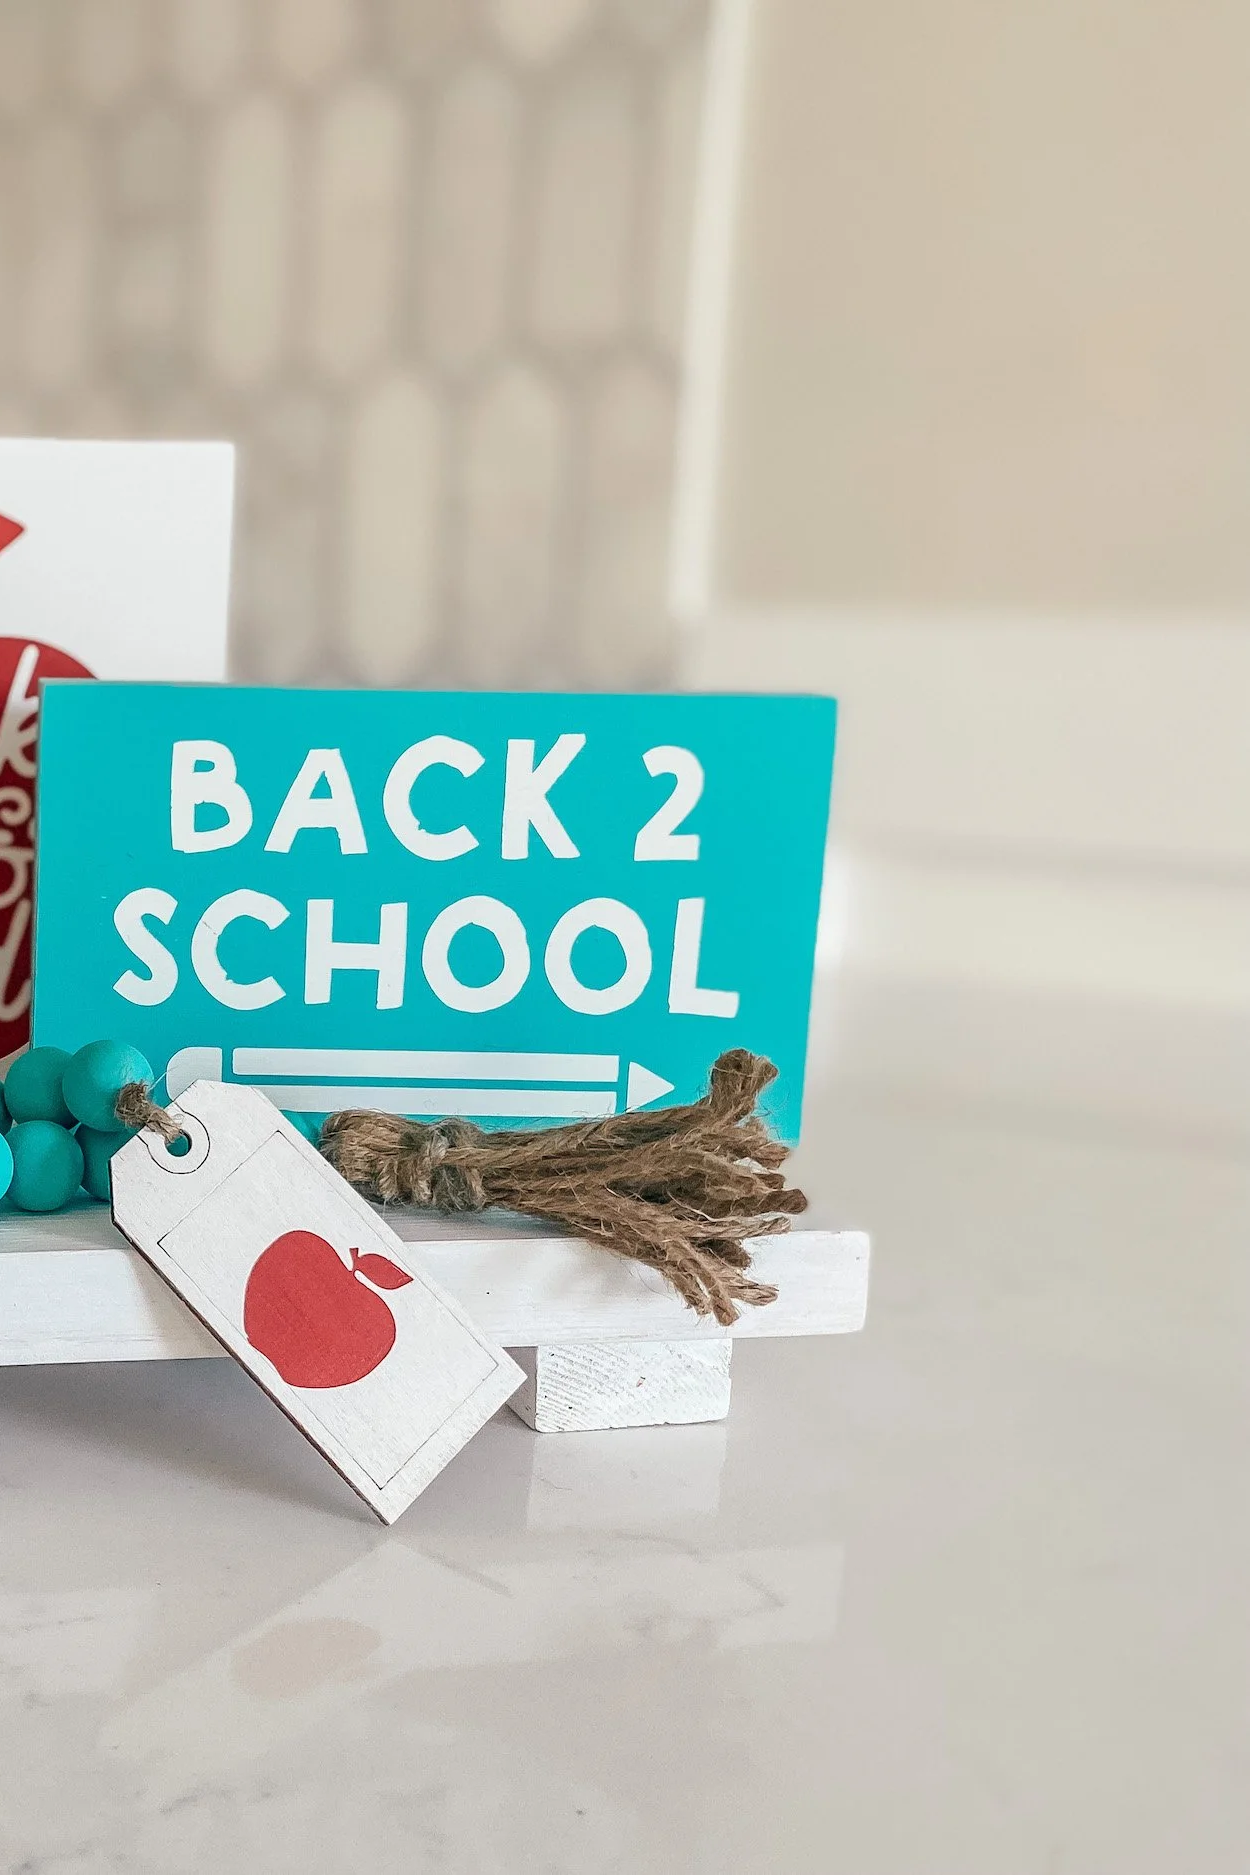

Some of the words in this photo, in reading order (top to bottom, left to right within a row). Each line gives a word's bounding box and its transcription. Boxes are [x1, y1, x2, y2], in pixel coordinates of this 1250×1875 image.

[169, 732, 587, 862] BACK
[632, 744, 705, 862] 2
[111, 886, 740, 1019] SCHOOL
